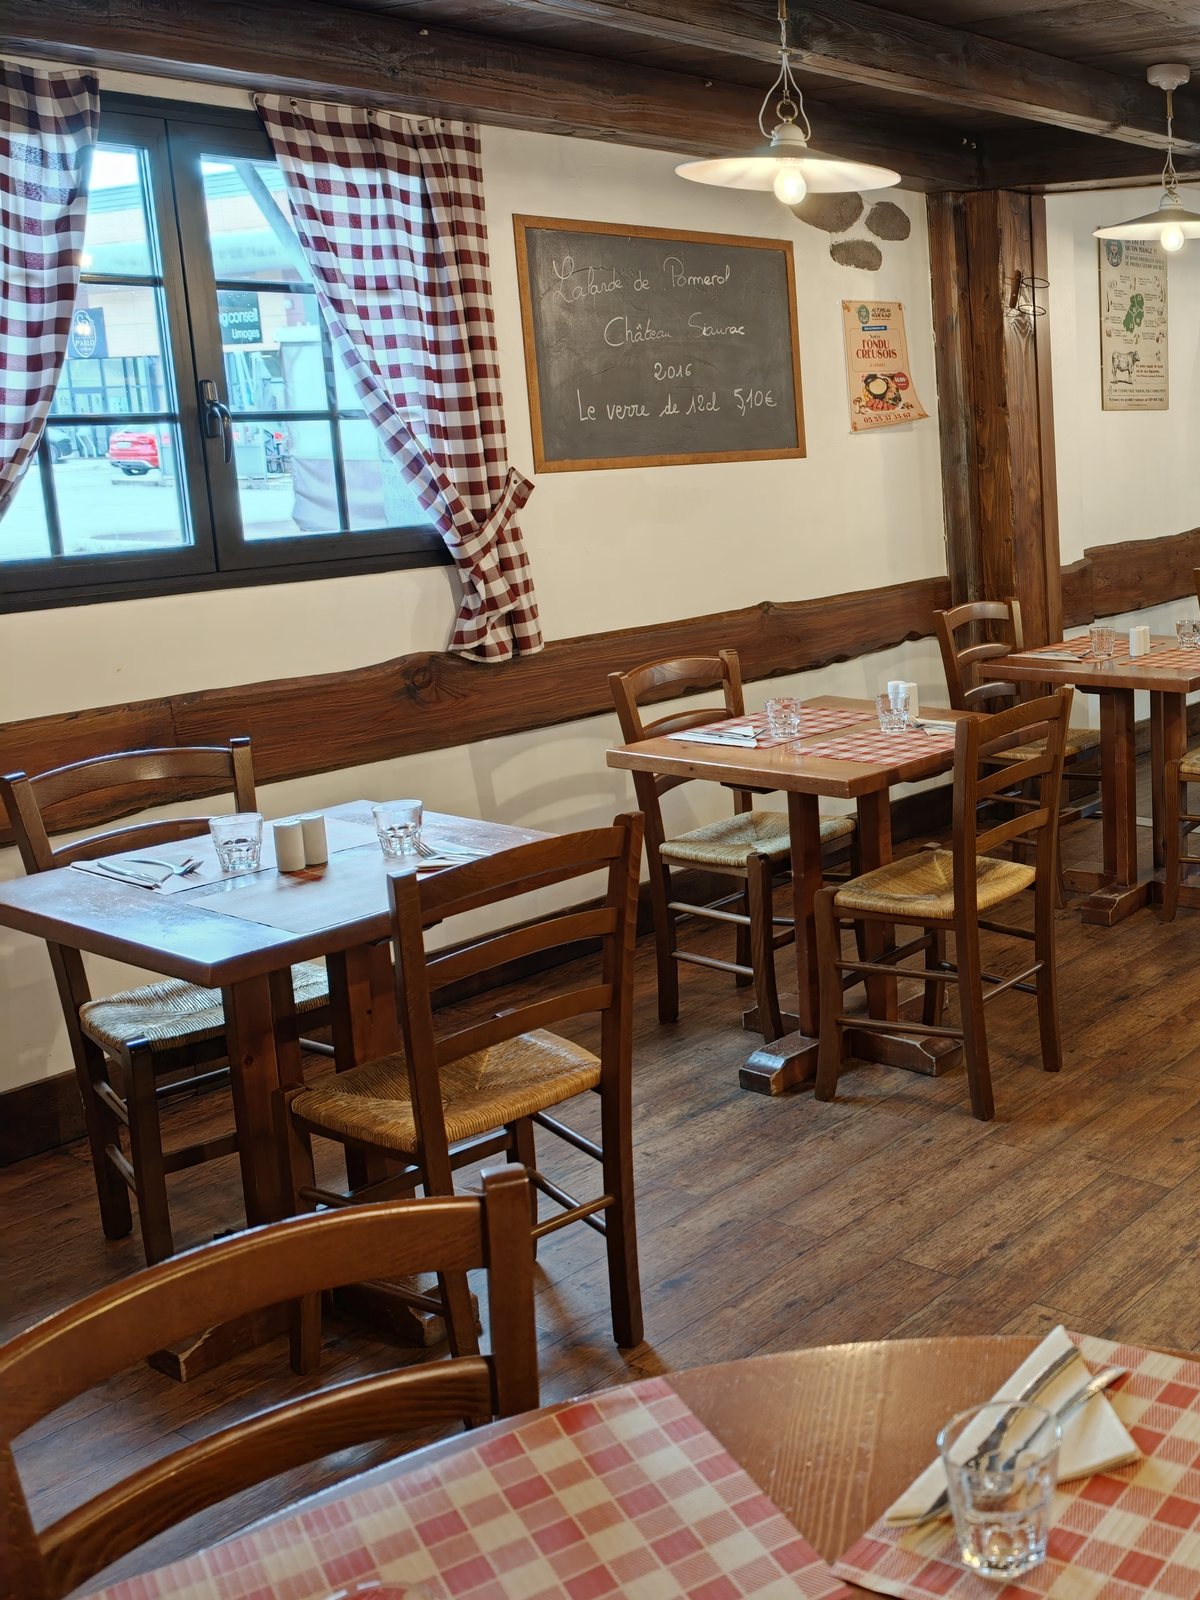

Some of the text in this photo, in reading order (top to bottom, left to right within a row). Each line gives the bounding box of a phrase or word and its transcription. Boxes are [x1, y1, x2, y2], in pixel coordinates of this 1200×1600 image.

[553, 256, 623, 302] Lalande
[634, 270, 650, 292] de
[231, 328, 260, 341] Limoges
[604, 315, 673, 347] Château
[862, 339, 889, 349] FONDU
[856, 349, 897, 359] CREUSOIS
[653, 362, 693, 381] 2016
[576, 388, 778, 421] Le verre de 12cl 5,10€
